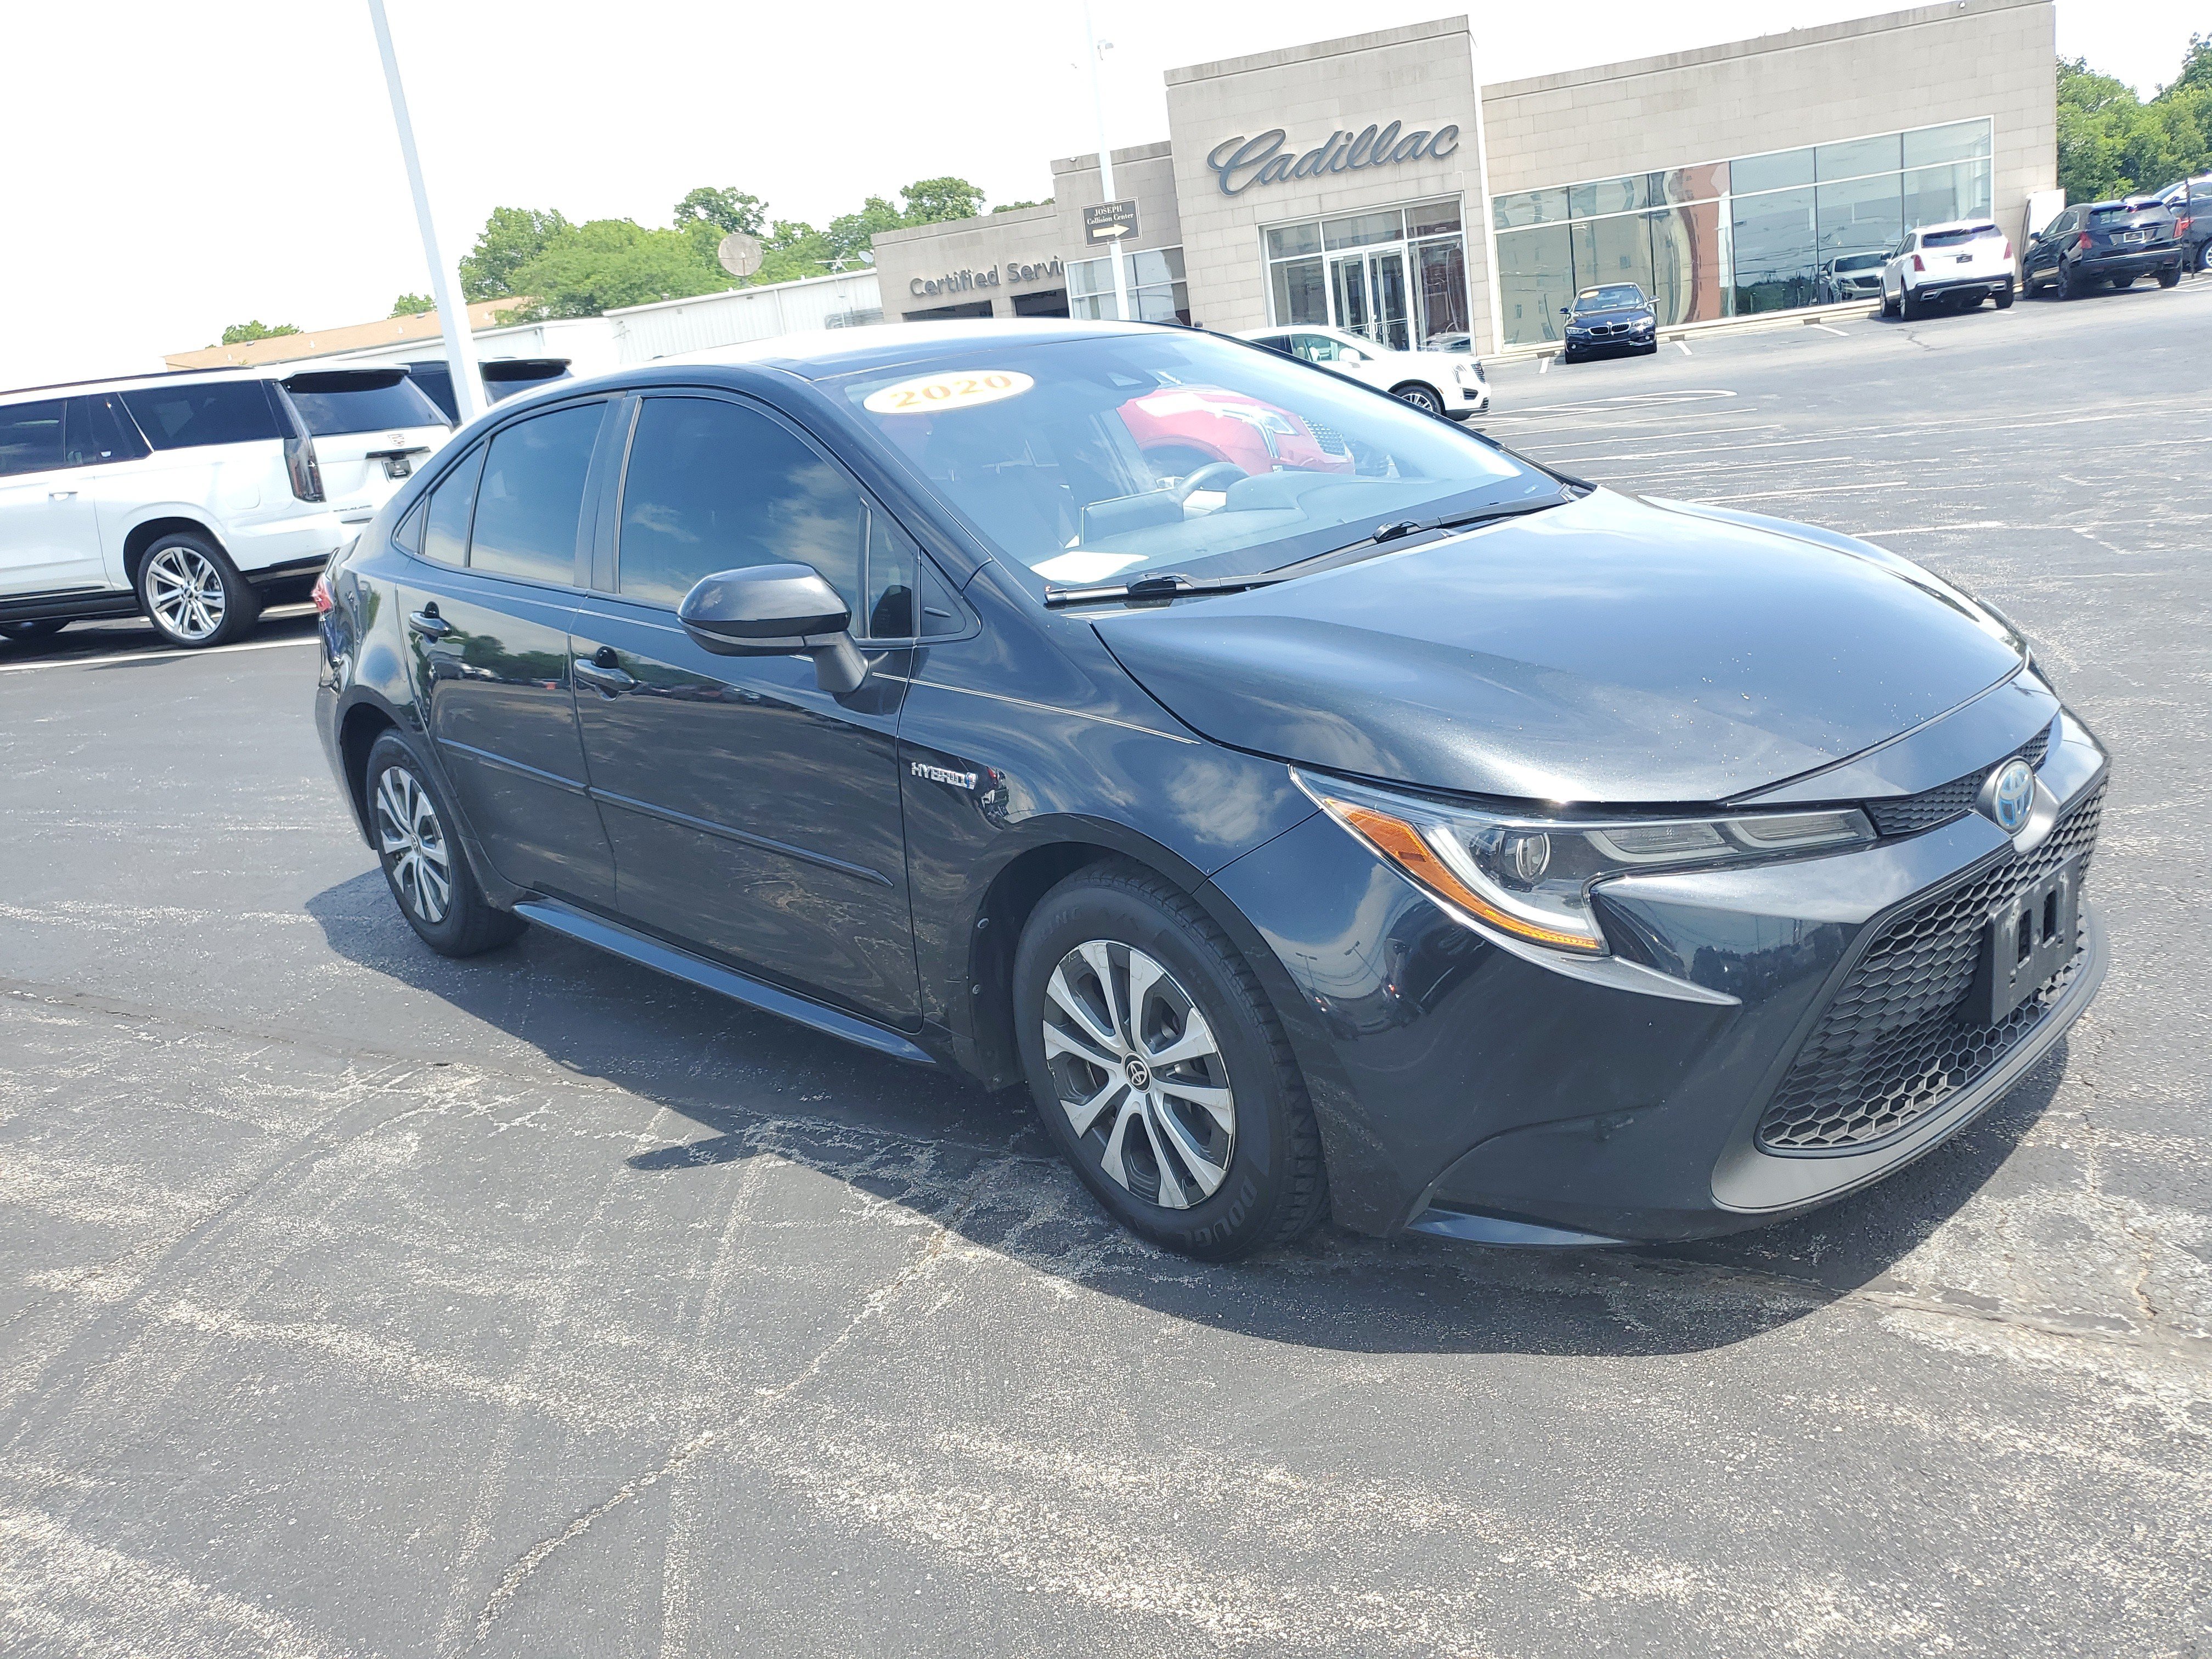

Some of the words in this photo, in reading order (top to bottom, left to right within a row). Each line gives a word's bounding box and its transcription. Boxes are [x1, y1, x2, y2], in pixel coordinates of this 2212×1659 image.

[1207, 120, 1459, 196] Cadillac
[1087, 216, 1113, 225] Collision
[1094, 205, 1122, 216] JOSEPH
[910, 264, 1001, 297] Certified
[1007, 255, 1064, 283] Servi
[889, 375, 1012, 408] 2020
[911, 762, 977, 790] HYBRID
